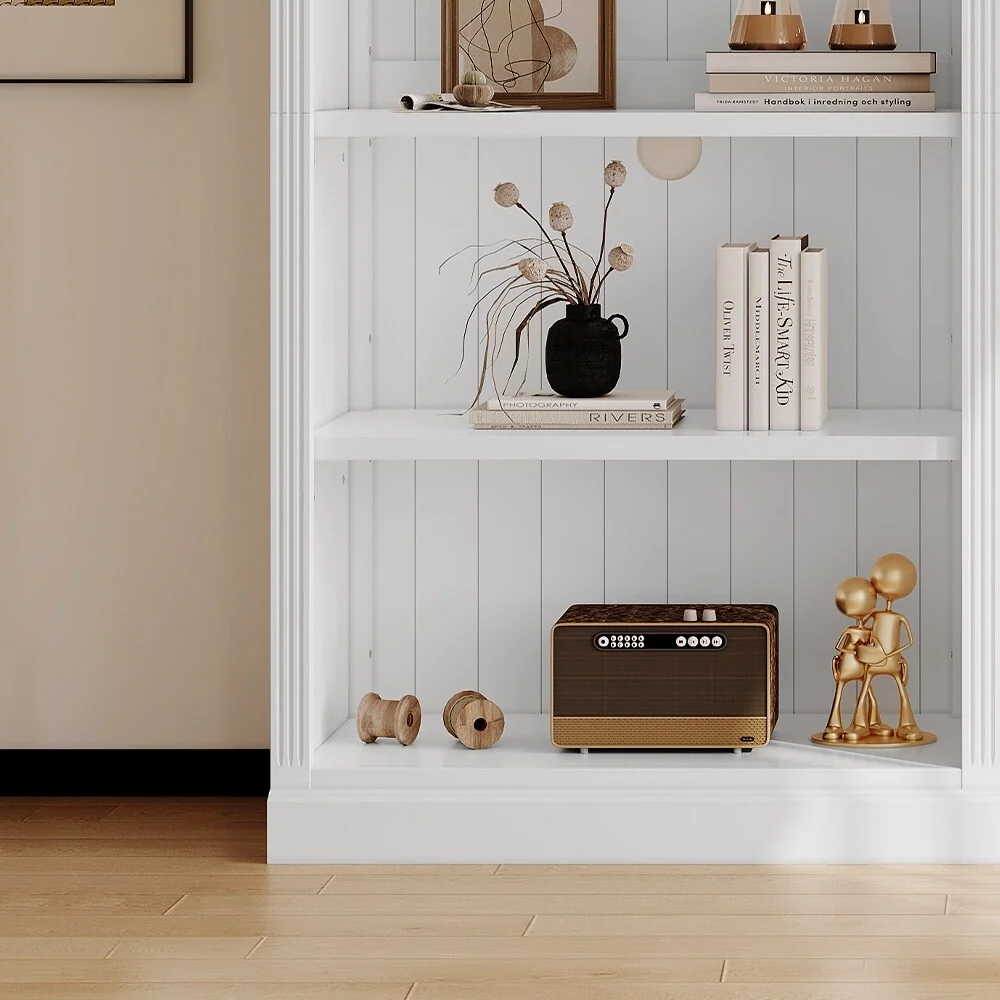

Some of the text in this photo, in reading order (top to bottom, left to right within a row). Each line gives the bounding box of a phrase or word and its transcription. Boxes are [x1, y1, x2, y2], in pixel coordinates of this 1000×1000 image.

[764, 75, 892, 83] VICTORIA HAGAN
[764, 98, 805, 106] Handbok
[814, 98, 858, 107] inredning
[862, 98, 878, 106] och
[881, 98, 912, 107] styling
[777, 254, 792, 277] The
[723, 300, 735, 377] OLIVER TWIST
[589, 413, 666, 423] RIVERS
